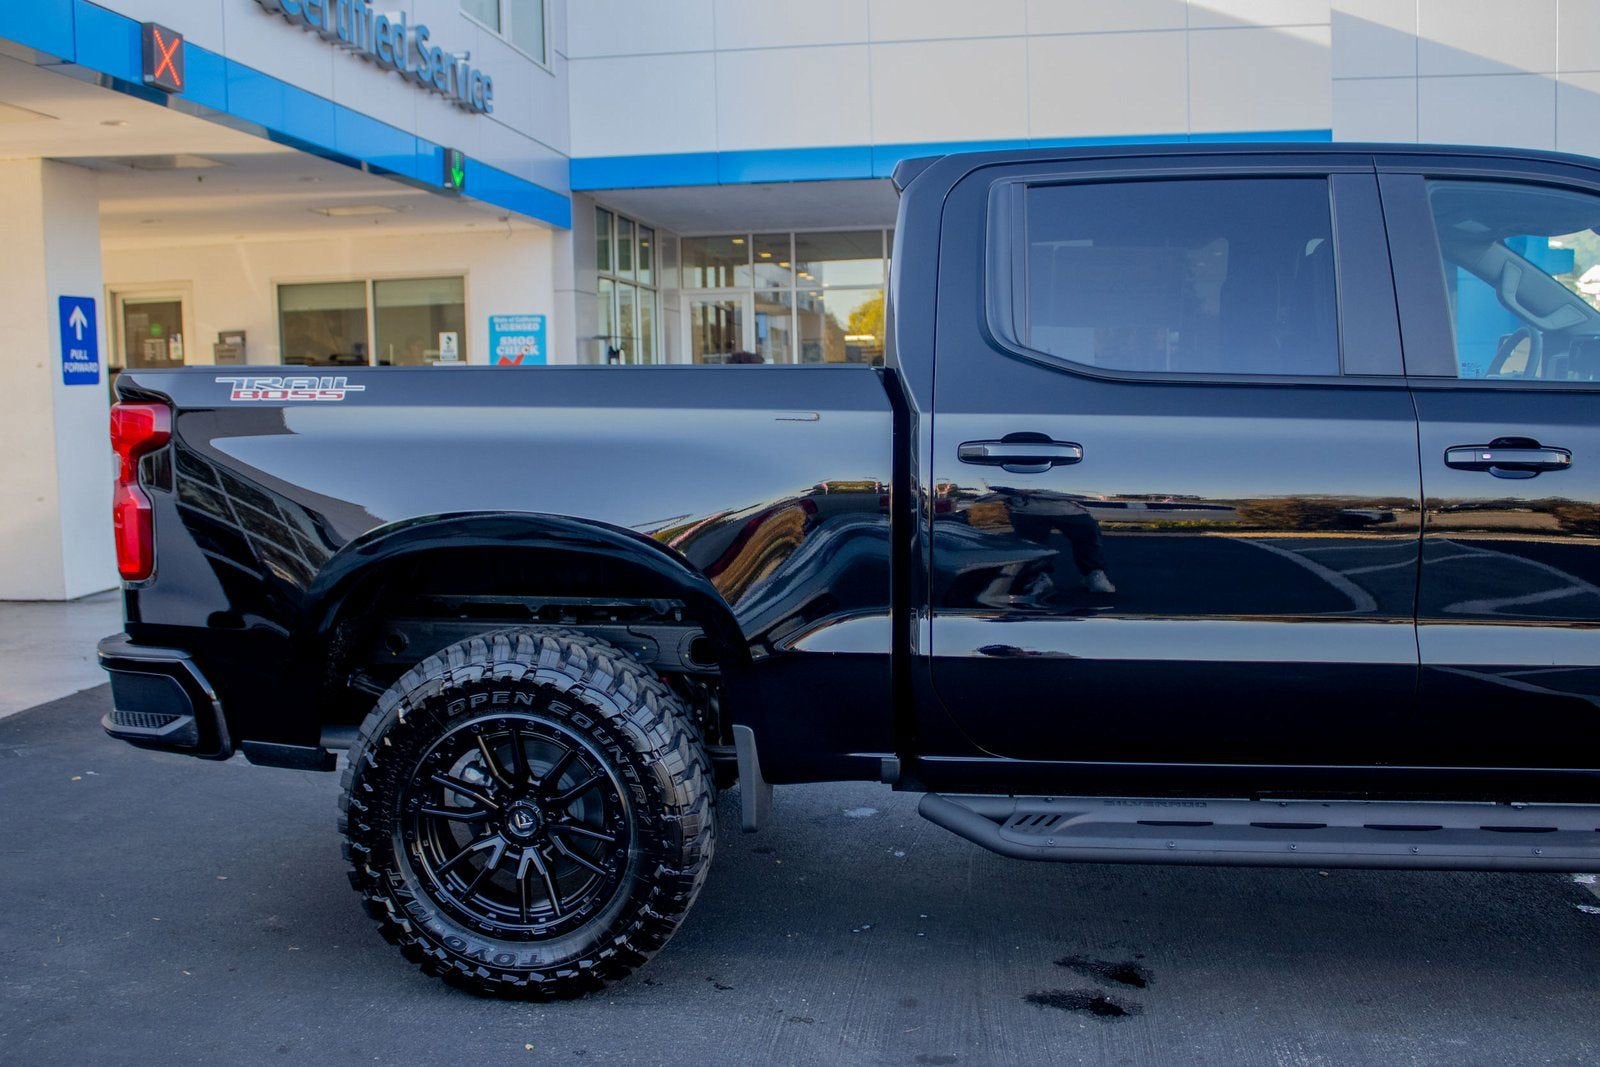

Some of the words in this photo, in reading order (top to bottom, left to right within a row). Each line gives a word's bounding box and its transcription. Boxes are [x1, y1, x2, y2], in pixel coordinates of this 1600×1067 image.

[278, 0, 407, 71] ertified
[415, 24, 495, 114] Service
[495, 323, 540, 332] LICENSED
[499, 335, 537, 346] SMOG
[69, 349, 89, 360] PULL
[496, 345, 540, 356] CHECK
[63, 361, 99, 373] FORWARD
[215, 376, 366, 391] TRAIL
[230, 388, 346, 401] BOSS
[447, 691, 536, 717] OPEN
[548, 700, 653, 825] COUNTRY
[442, 935, 546, 969] TOYO
